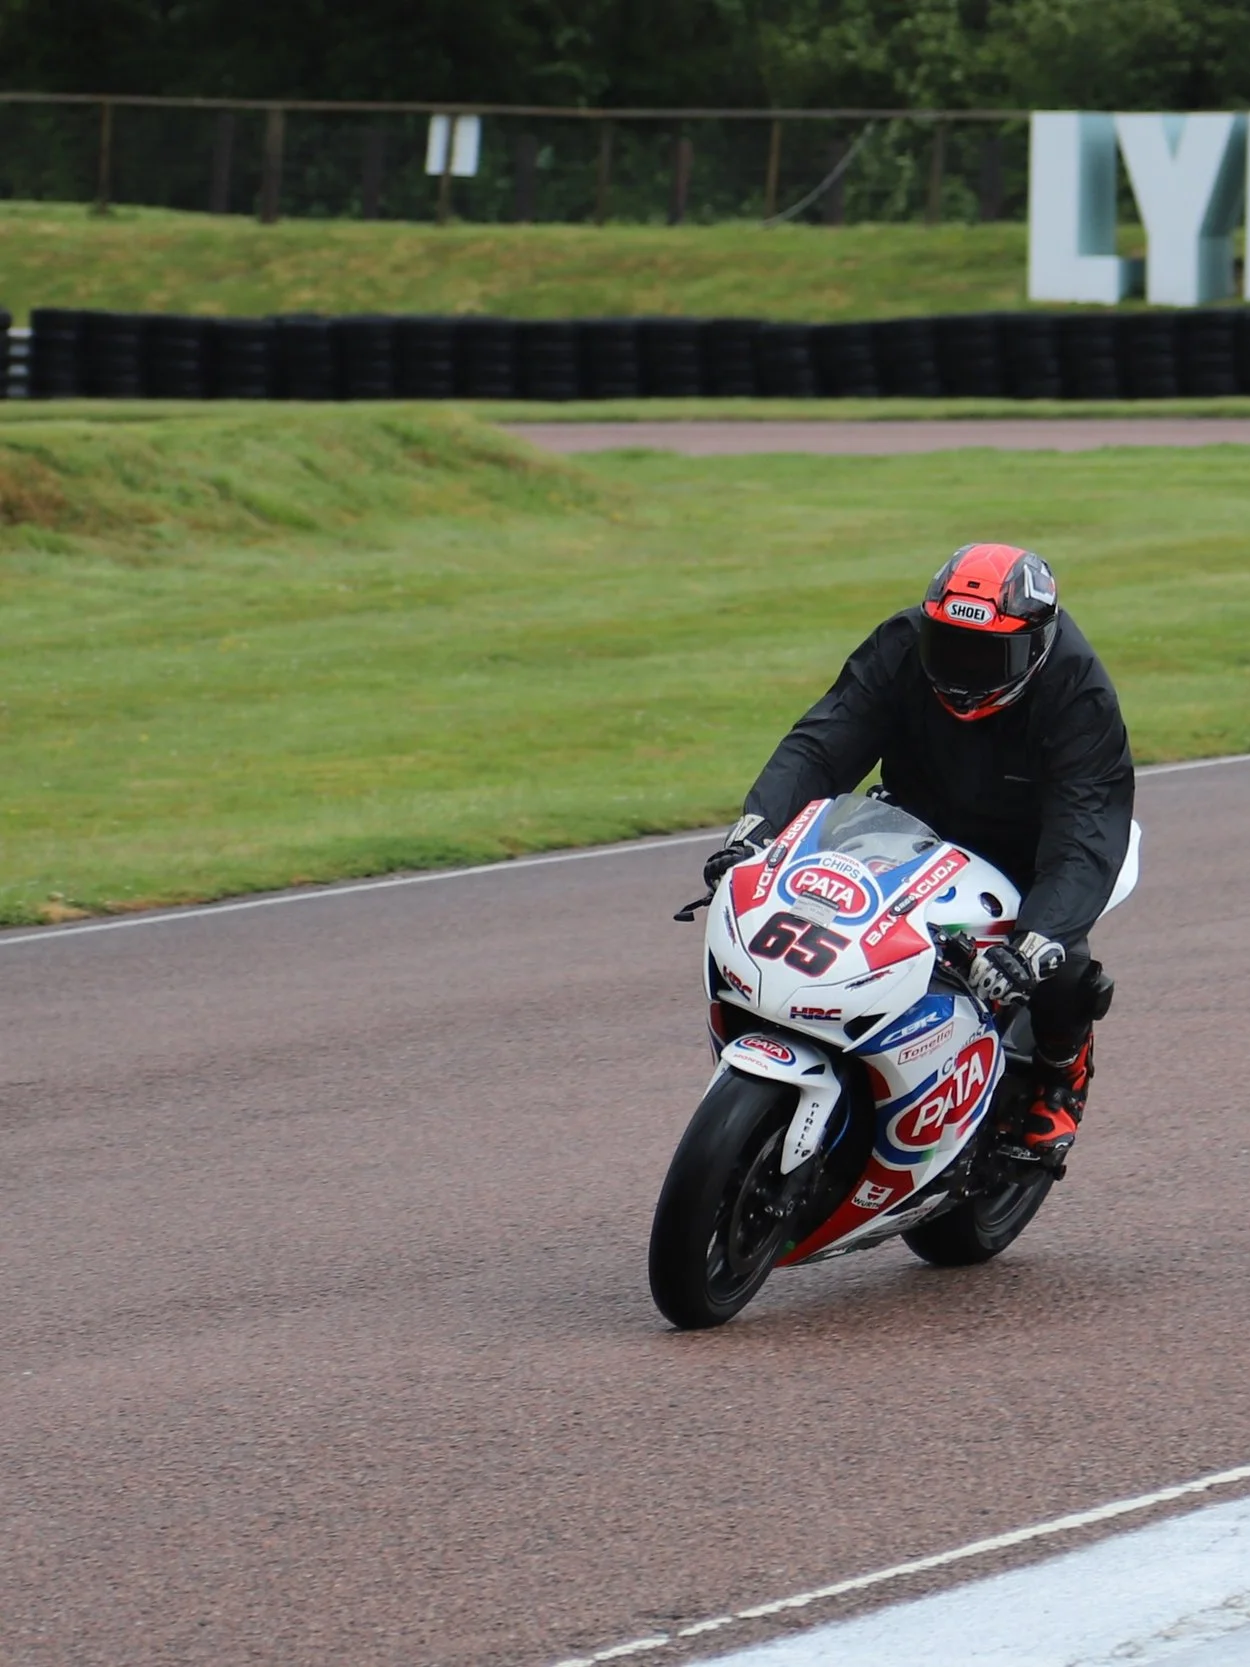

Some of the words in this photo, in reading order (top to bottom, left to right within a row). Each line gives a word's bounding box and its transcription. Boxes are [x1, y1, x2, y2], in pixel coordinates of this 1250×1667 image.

[951, 603, 985, 621] SHOEI
[822, 857, 861, 880] CHIPS
[796, 871, 855, 910] PATA
[748, 911, 852, 978] 65
[722, 964, 753, 1001] HRC
[789, 1006, 842, 1021] HRC
[880, 1012, 943, 1047] CBR
[746, 1039, 784, 1058] PATA
[903, 1029, 952, 1061] Tonello
[911, 1051, 985, 1138] PATA
[794, 1102, 820, 1155] PIRELLI
